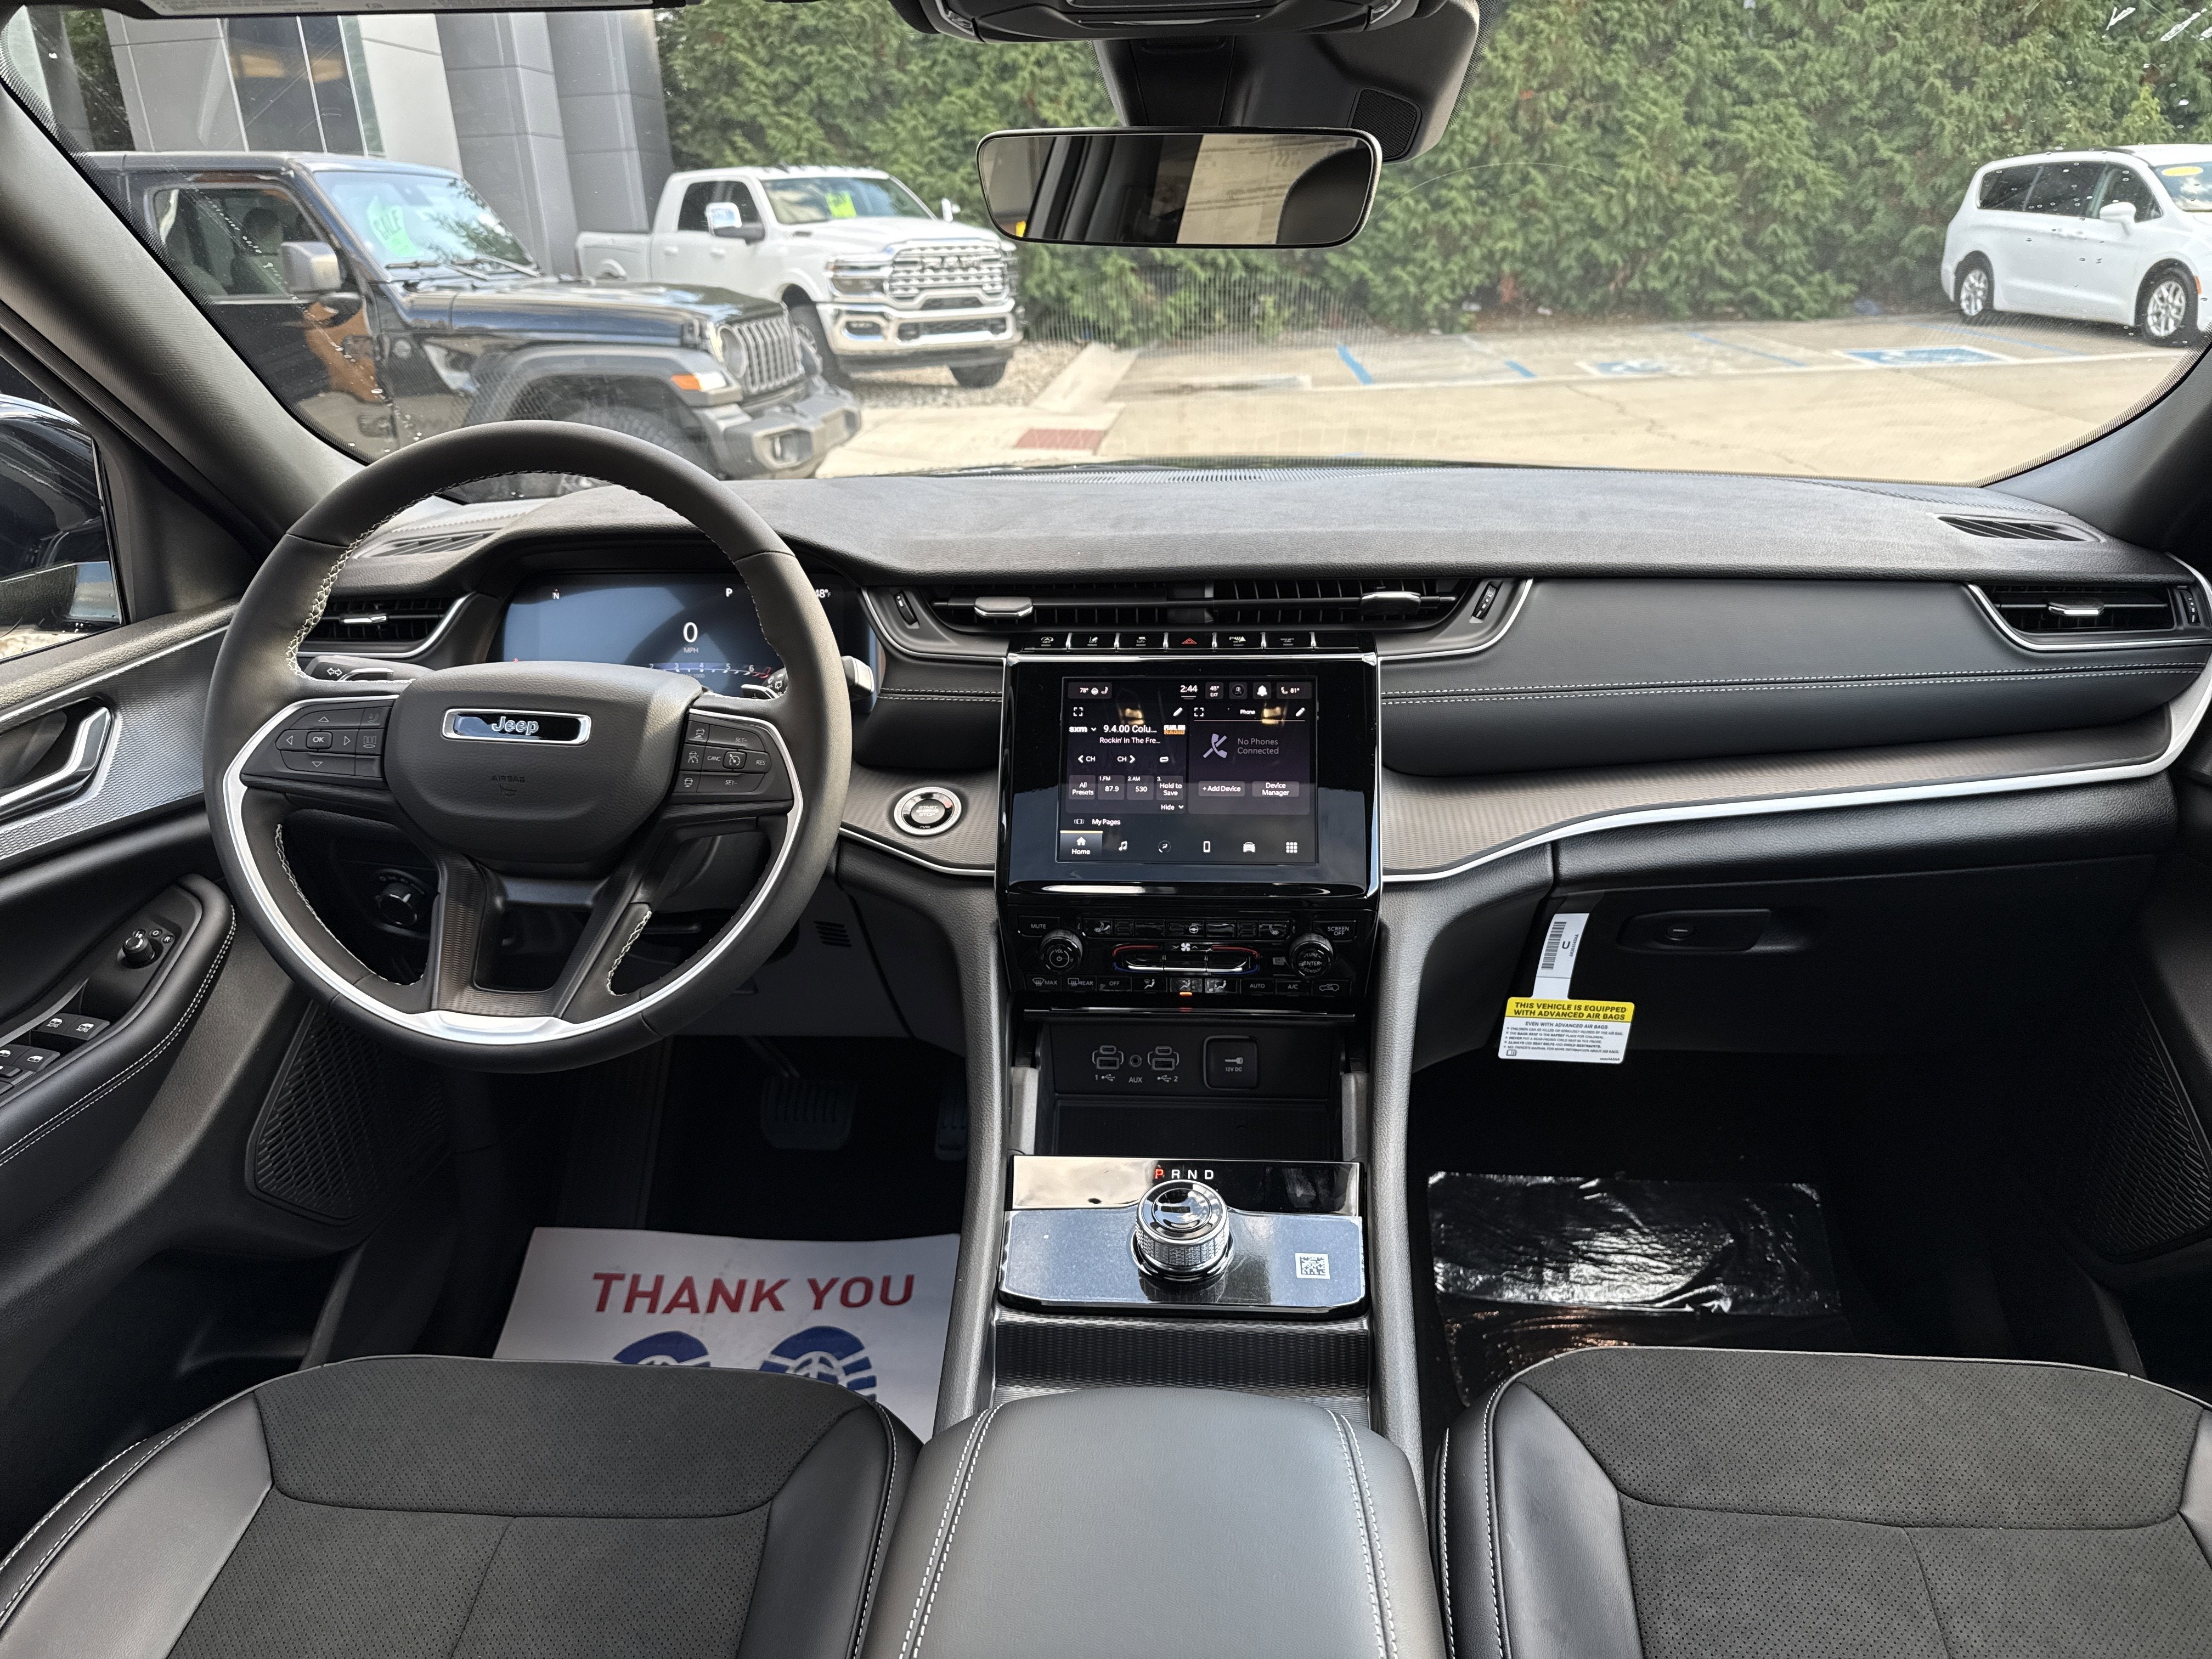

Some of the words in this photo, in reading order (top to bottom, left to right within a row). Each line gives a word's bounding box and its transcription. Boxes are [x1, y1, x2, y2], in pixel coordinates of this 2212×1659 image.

[726, 588, 733, 597] P
[683, 622, 698, 643] 0
[492, 716, 539, 736] Jeep
[1103, 724, 1130, 733] 9.4.00
[492, 775, 525, 783] AIRBAG
[1155, 1168, 1164, 1179] P
[1171, 1169, 1180, 1179] R
[1188, 1170, 1197, 1180] N
[1204, 1170, 1214, 1180] D
[592, 1273, 790, 1314] THANK
[808, 1274, 915, 1310] YOU
